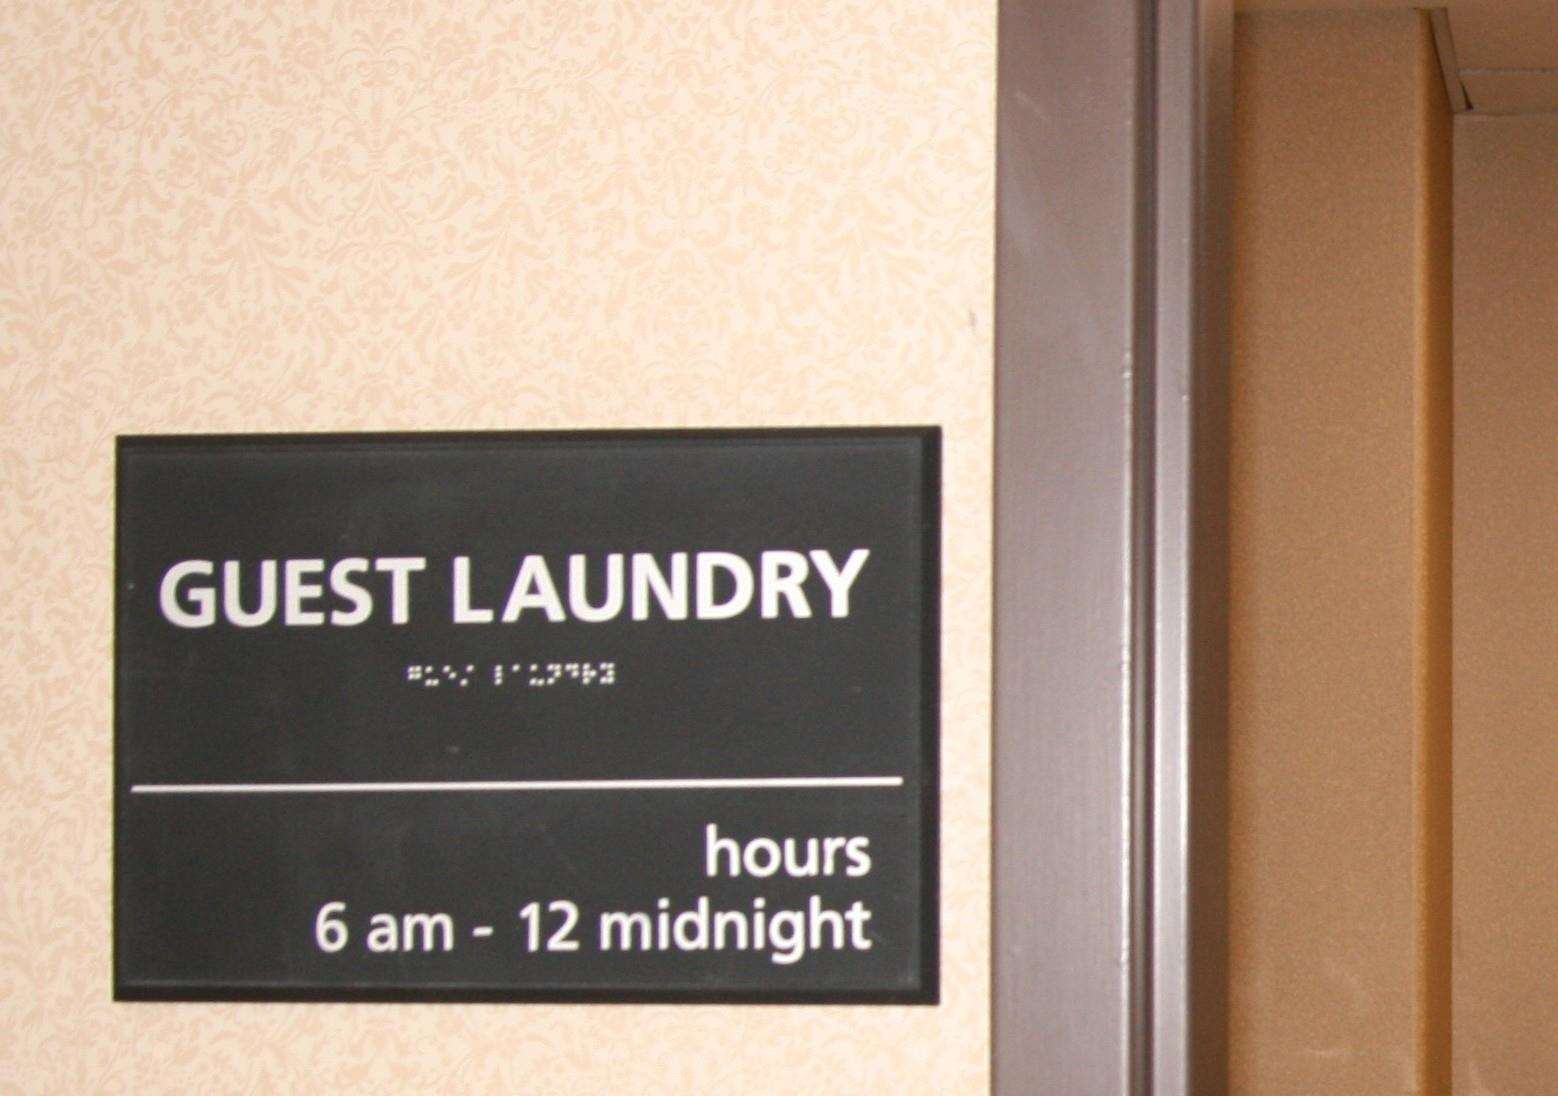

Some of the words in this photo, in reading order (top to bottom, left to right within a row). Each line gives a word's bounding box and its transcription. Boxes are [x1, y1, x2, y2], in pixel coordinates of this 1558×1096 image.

[160, 556, 427, 628] GUEST
[453, 548, 870, 624] LAUNDRY
[705, 822, 872, 878] hours
[315, 901, 349, 953] 6
[366, 913, 454, 953] am
[519, 899, 580, 952] 12
[600, 894, 873, 965] midnight
